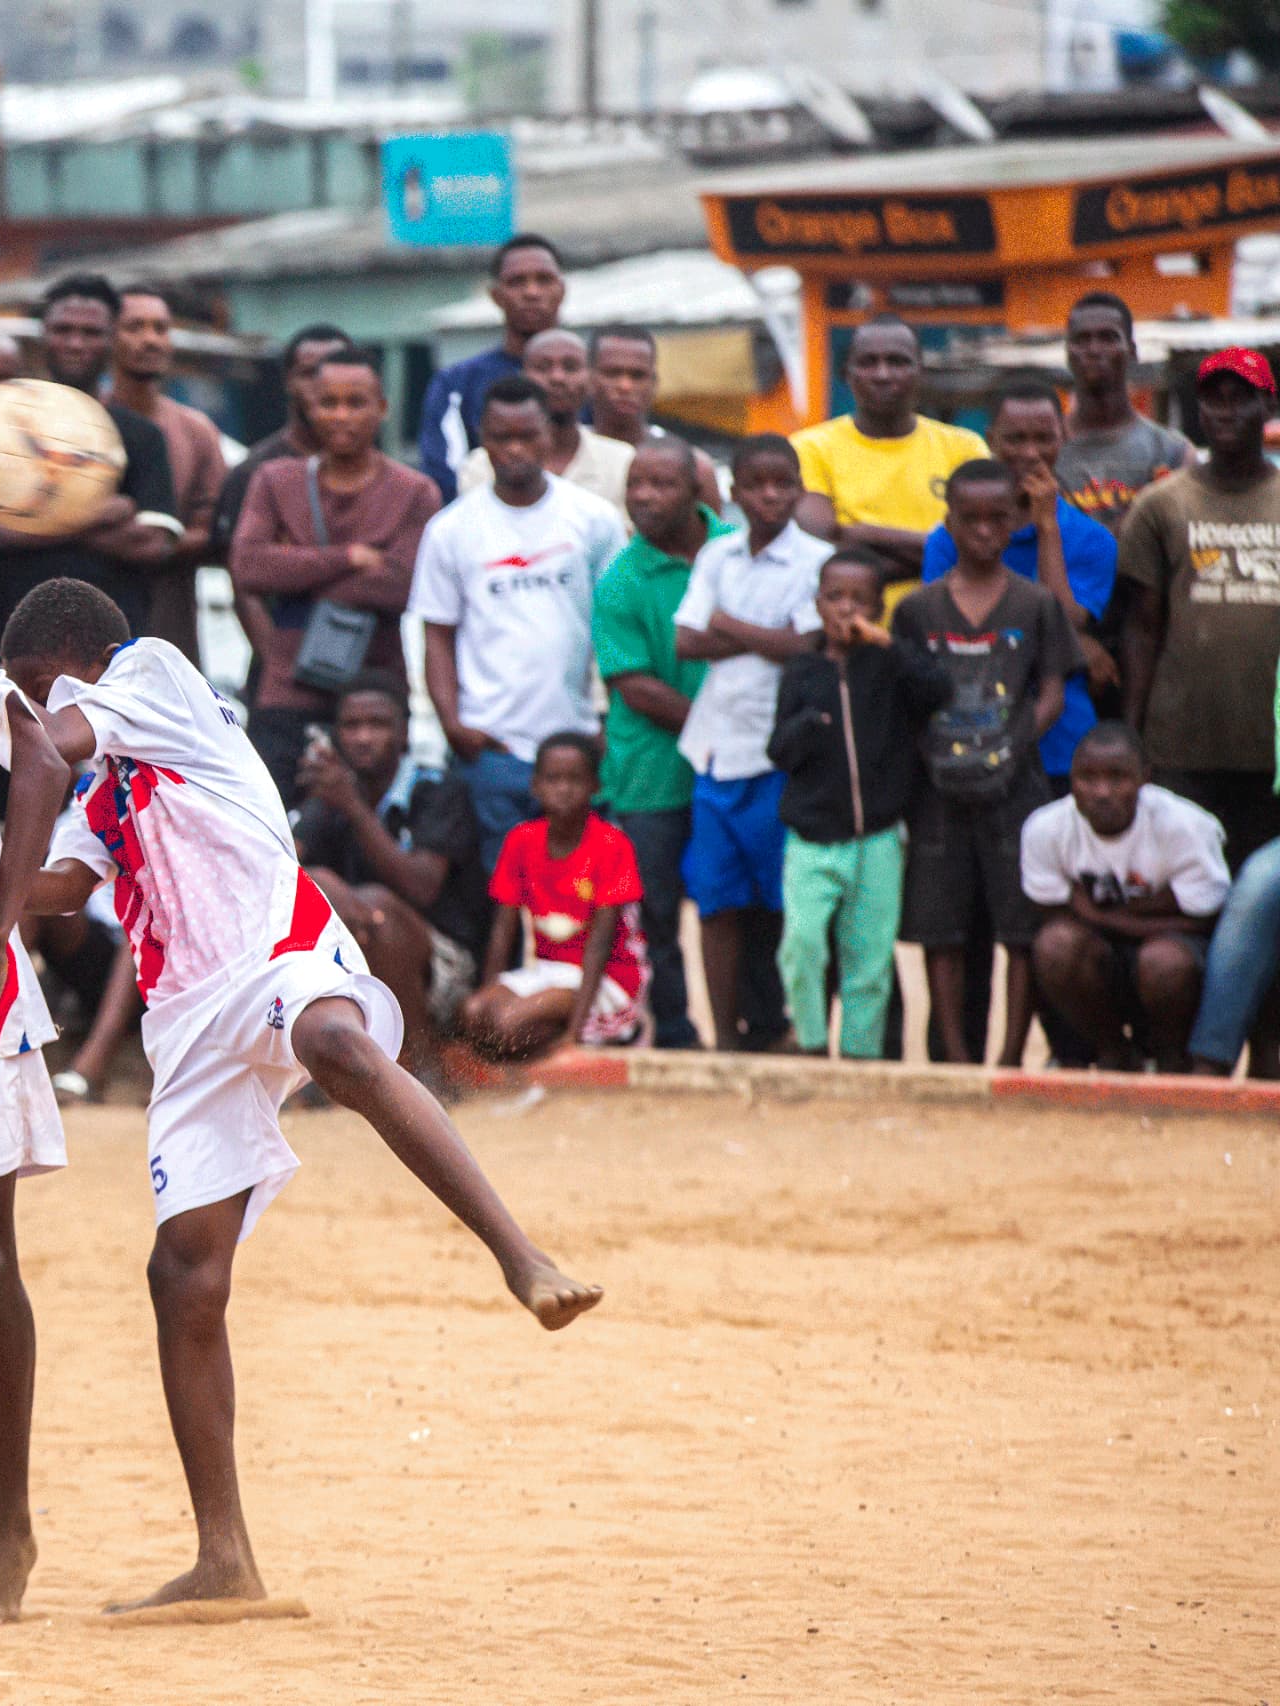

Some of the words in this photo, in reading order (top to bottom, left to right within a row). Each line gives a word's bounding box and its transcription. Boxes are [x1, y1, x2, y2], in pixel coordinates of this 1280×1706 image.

[756, 199, 878, 252] Orange
[883, 200, 957, 243] Box
[1107, 186, 1218, 230] Orange
